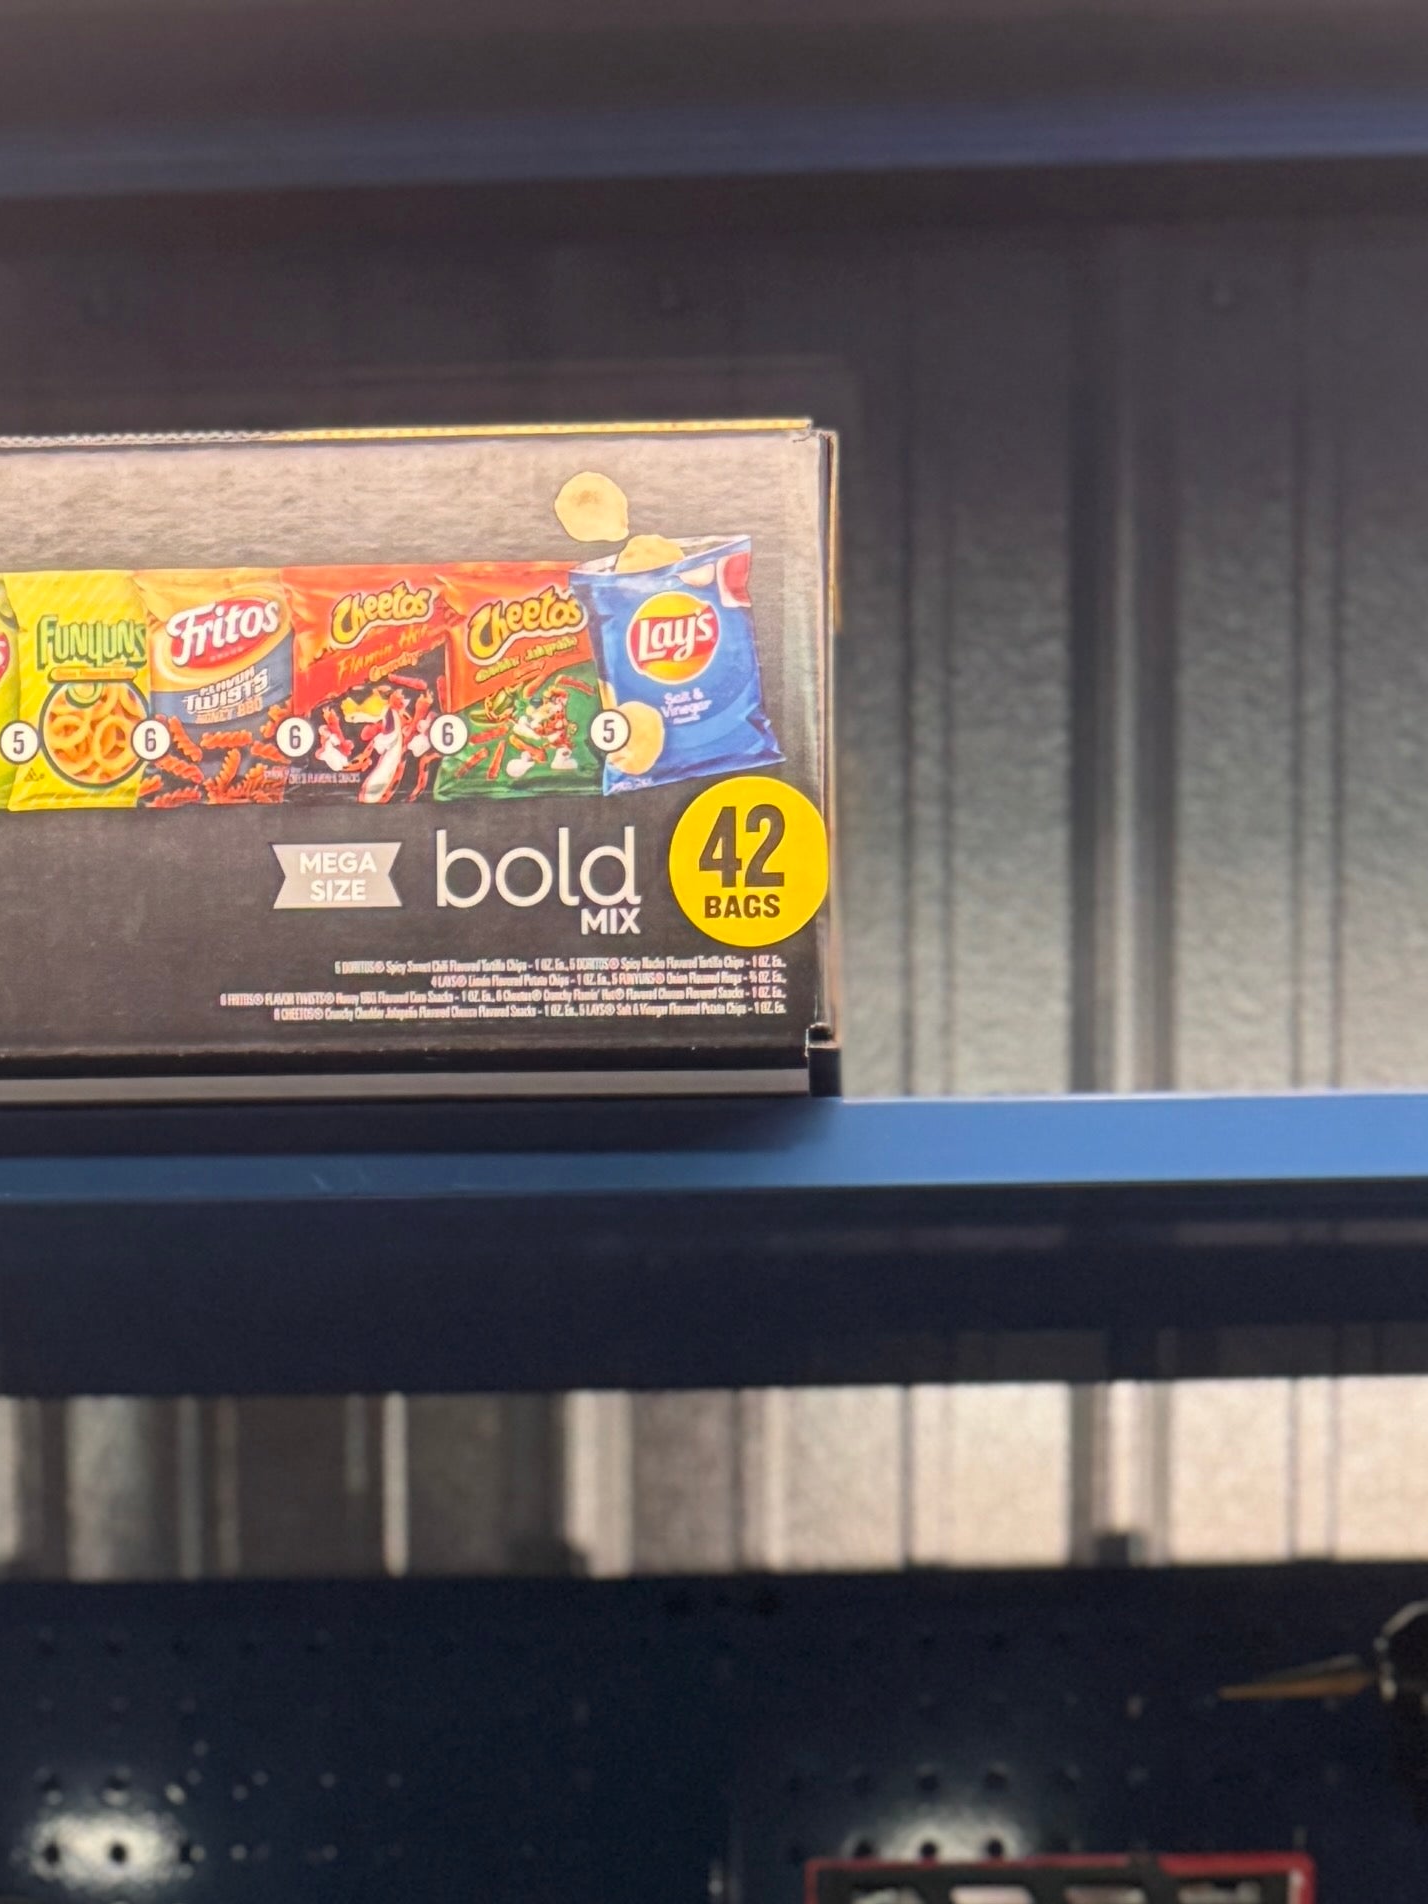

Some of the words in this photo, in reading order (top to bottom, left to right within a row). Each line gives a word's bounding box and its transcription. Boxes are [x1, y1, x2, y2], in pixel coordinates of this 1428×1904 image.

[330, 580, 432, 646] Cheetos
[467, 585, 585, 660] Cheetos
[166, 600, 280, 668] Fritos
[182, 668, 270, 714] TWISTS
[12, 728, 25, 753] 5
[144, 727, 158, 752] 6
[288, 724, 302, 750] 6
[441, 722, 455, 747] 6
[602, 718, 616, 744] 5
[698, 804, 786, 889] 42
[298, 852, 378, 875] MEGA
[435, 826, 642, 908] bold
[309, 878, 367, 902] SIZE
[703, 894, 781, 919] BAGS
[579, 907, 641, 936] MIX
